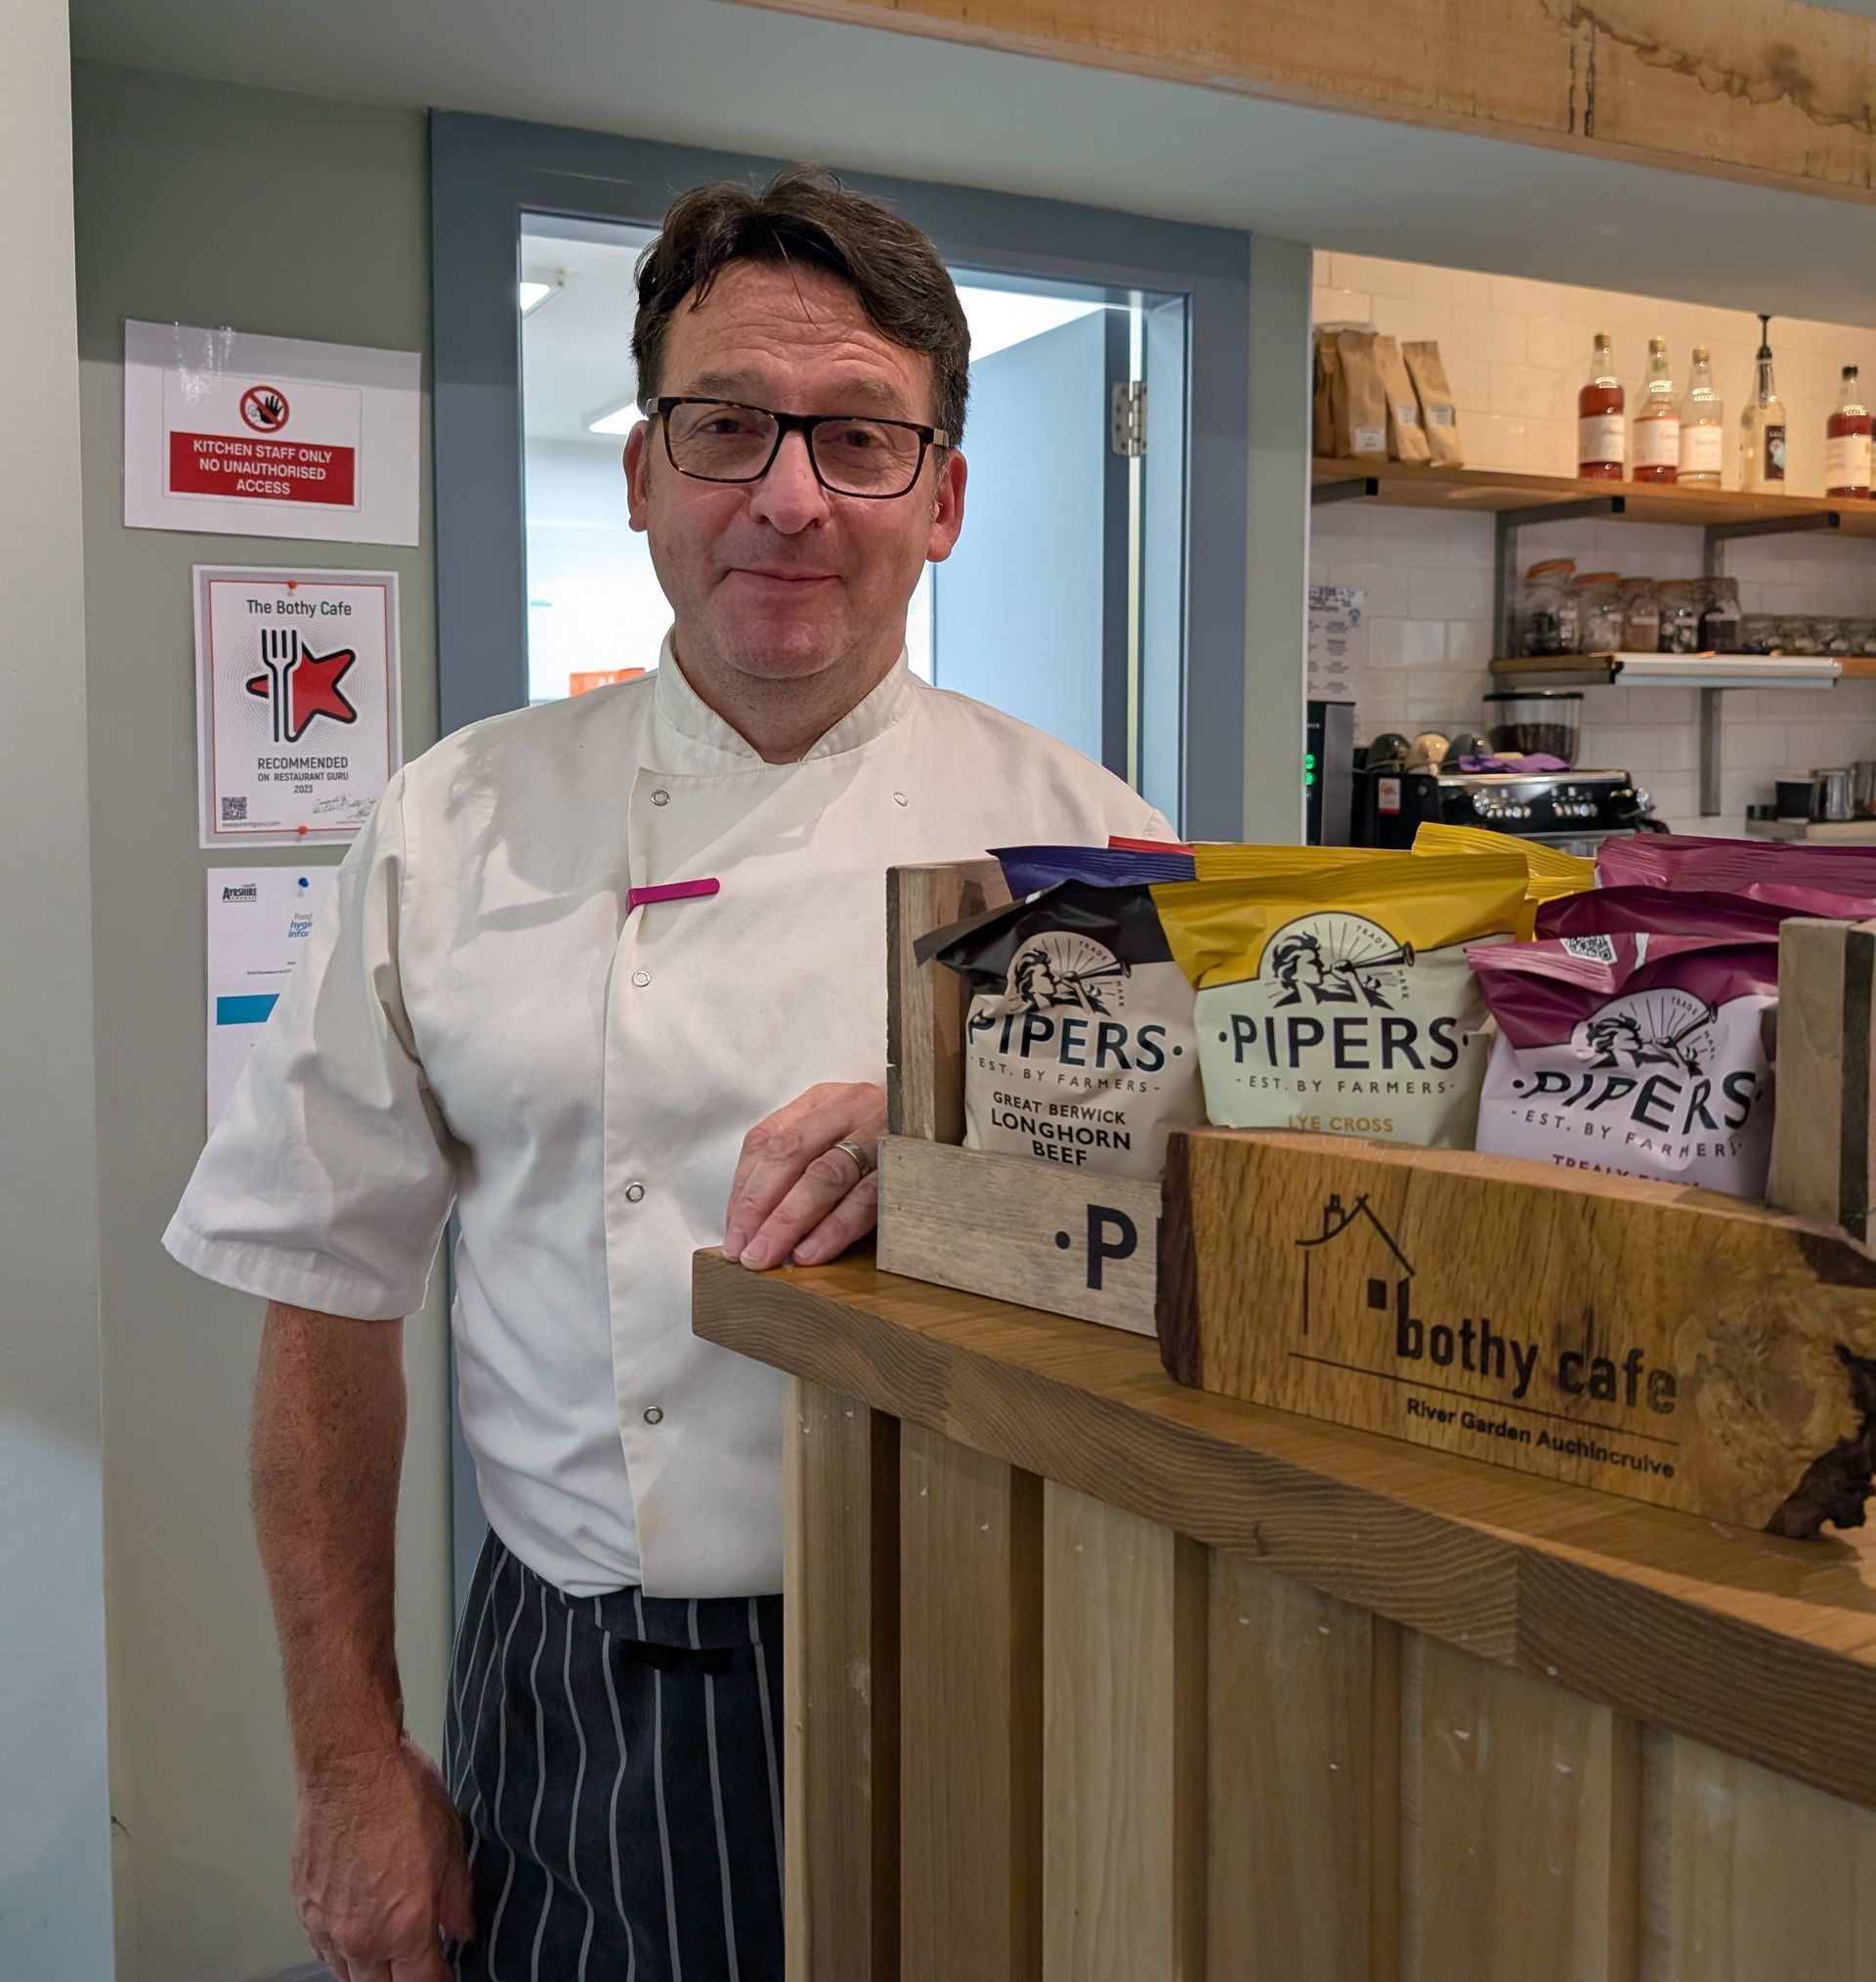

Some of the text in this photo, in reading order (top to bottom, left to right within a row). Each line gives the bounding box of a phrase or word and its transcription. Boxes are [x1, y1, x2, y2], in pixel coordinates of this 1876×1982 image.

[193, 440, 332, 463] KITCHEN STAFF ONLY
[199, 458, 326, 481] NO UNAUTHORISED
[236, 479, 290, 496] ACCESS
[246, 599, 352, 619] The Bothy Cafe
[257, 756, 349, 770] RECOMMENDED
[257, 771, 349, 782] ON RESTAURANT GURU
[293, 785, 314, 794] 2023
[221, 820, 281, 829] restaurantguru.com
[1355, 925, 1387, 949] TRADE
[1078, 940, 1109, 963] TRADE
[1115, 980, 1126, 1009] MARK
[1396, 969, 1409, 1001] MARK
[967, 1010, 1167, 1073] PIPERS
[1230, 1013, 1460, 1070] PIPERS
[1023, 1068, 1045, 1081] BY
[1057, 1074, 1148, 1094] FARMERS
[1298, 1080, 1322, 1093] BY
[1338, 1080, 1446, 1095] FARMERS
[993, 1092, 1127, 1126] GREAT BERWICK
[1518, 1071, 1756, 1135] PIPERS
[991, 1108, 1130, 1150] LONGHORN
[1289, 1115, 1394, 1133] LYE CROSS
[1584, 1123, 1611, 1140] BY
[1626, 1132, 1738, 1157] FARMERS
[1032, 1140, 1087, 1166] BEEF
[1396, 1276, 1678, 1415] bothy cafe
[1407, 1398, 1675, 1479] River Garden Auchincruive
